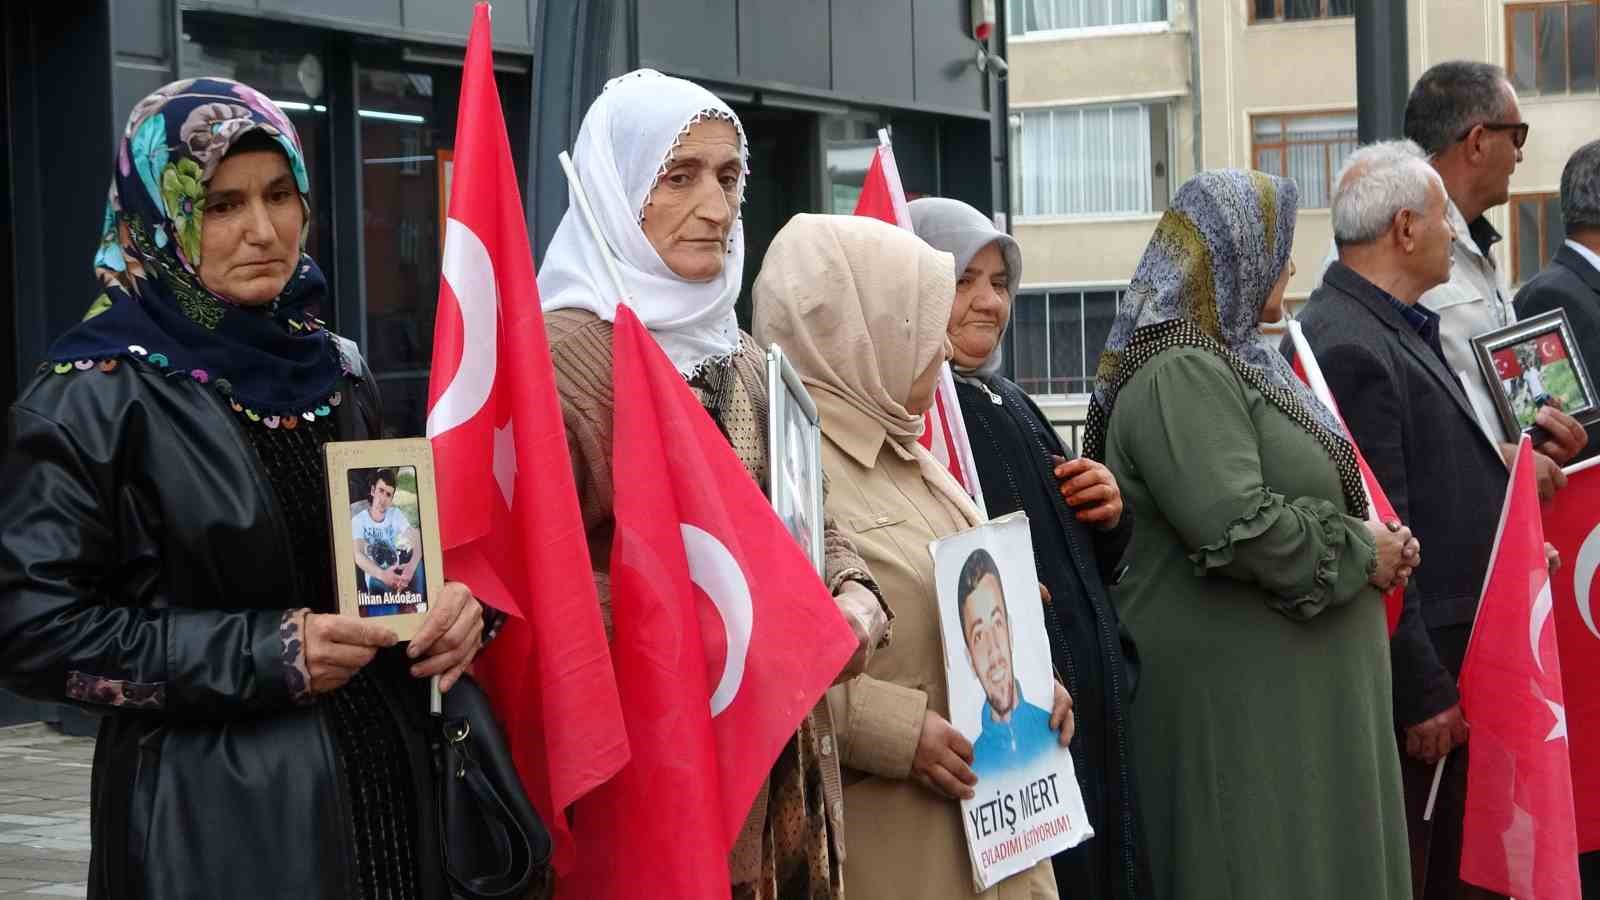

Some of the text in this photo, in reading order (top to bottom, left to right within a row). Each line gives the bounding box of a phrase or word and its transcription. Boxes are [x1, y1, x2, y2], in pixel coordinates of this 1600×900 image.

[358, 590, 422, 605] İlhan Akdoğan
[969, 773, 1060, 840] YETİŞ MERT
[981, 837, 1023, 868] EVLADIMI
